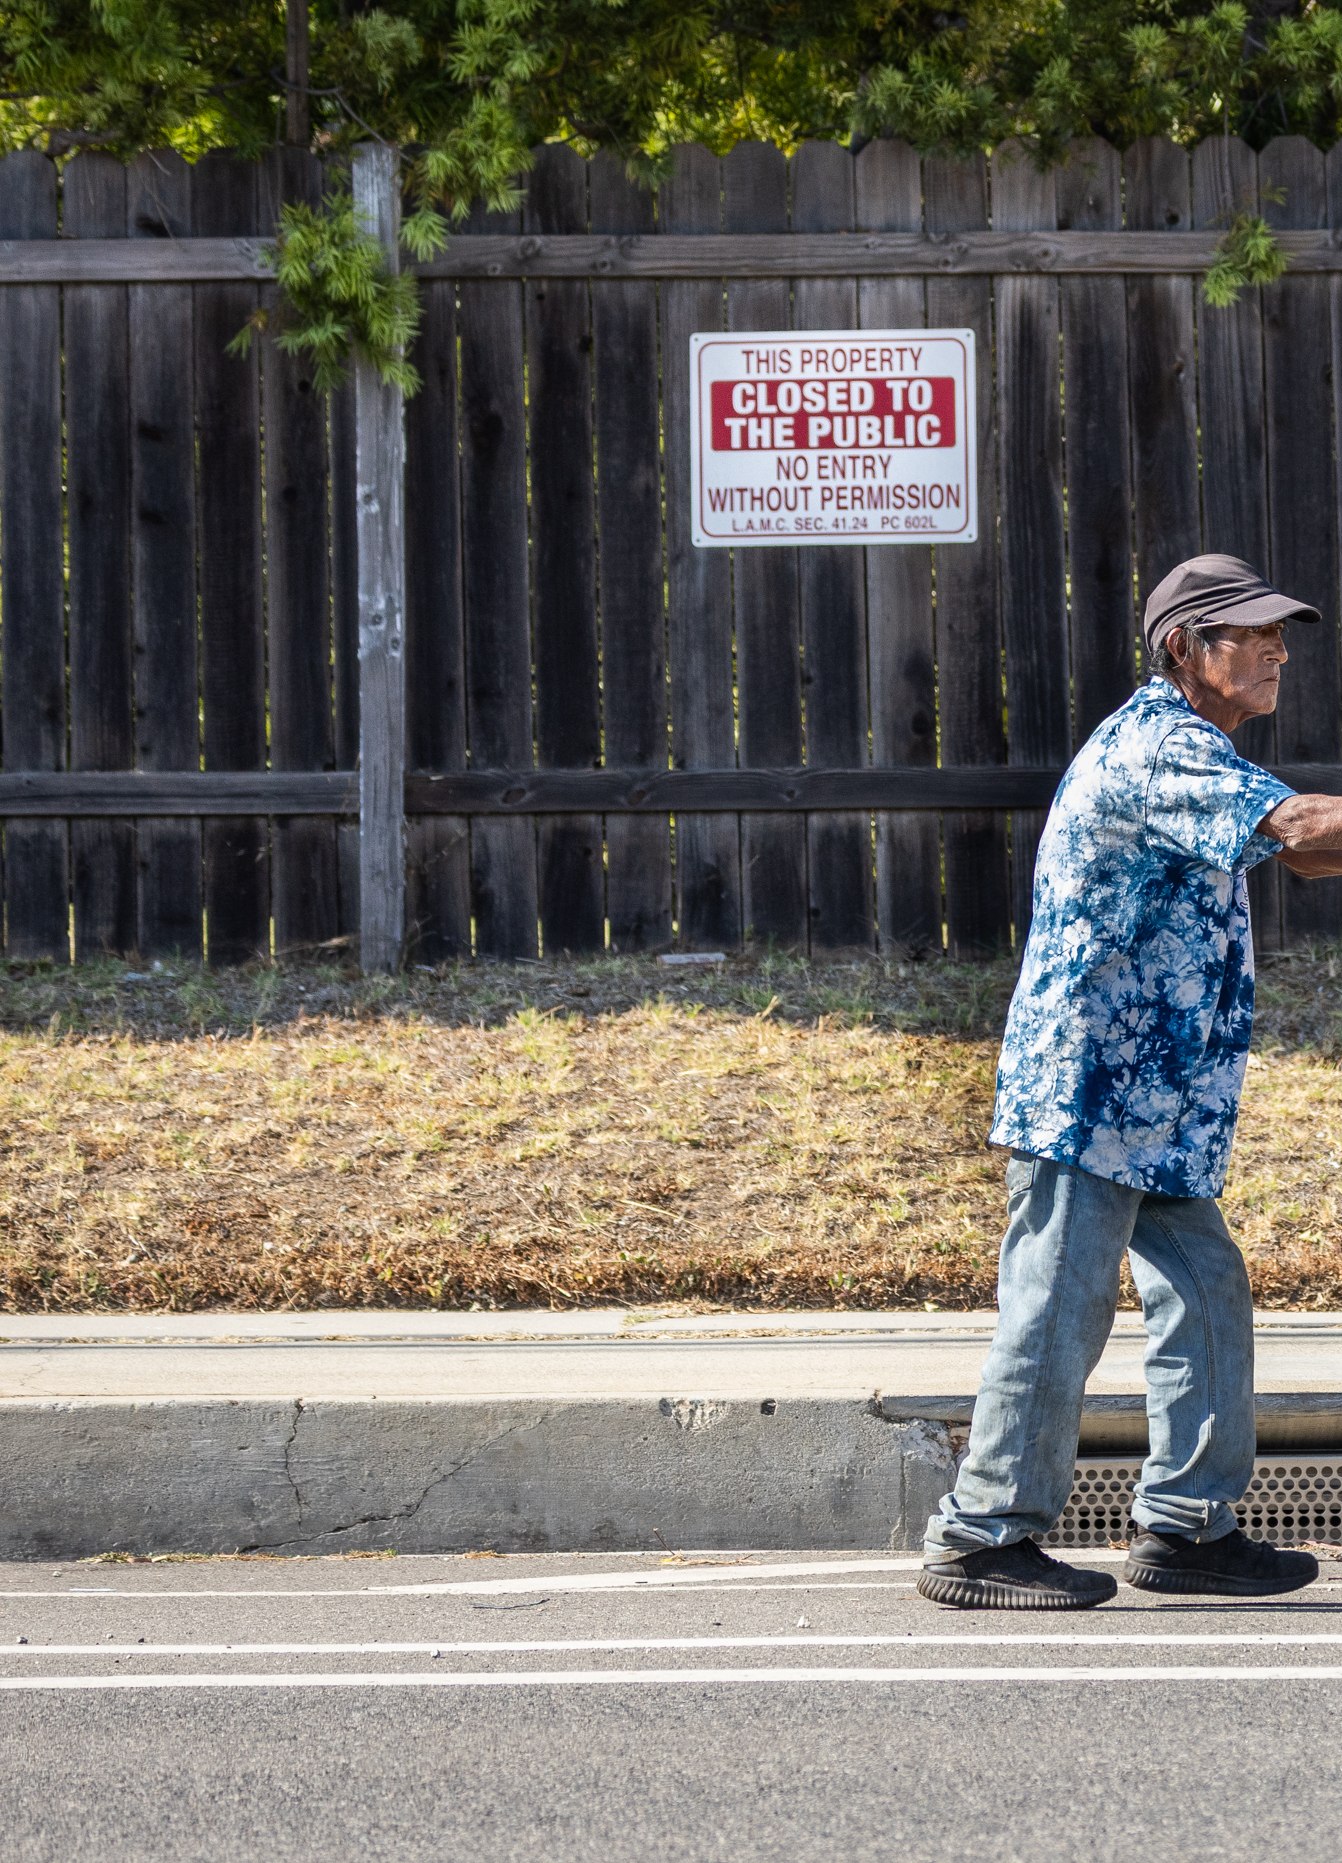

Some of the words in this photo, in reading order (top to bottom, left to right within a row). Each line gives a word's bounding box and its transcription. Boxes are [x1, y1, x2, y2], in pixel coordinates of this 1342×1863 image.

[741, 349, 792, 374] THIS
[800, 347, 923, 373] PROPERTY
[731, 380, 875, 415] CLOSED
[885, 378, 933, 412] TO
[724, 416, 795, 449] THE
[807, 414, 942, 448] PUBLIC
[776, 456, 809, 480] NO
[817, 455, 892, 480] ENTRY
[708, 486, 813, 512] WITHOUT
[820, 484, 961, 511] PERMISSION
[732, 517, 790, 532] L.A.M.C.
[794, 516, 828, 531] SEC.
[831, 516, 869, 530] 41.24
[881, 515, 901, 530] PC
